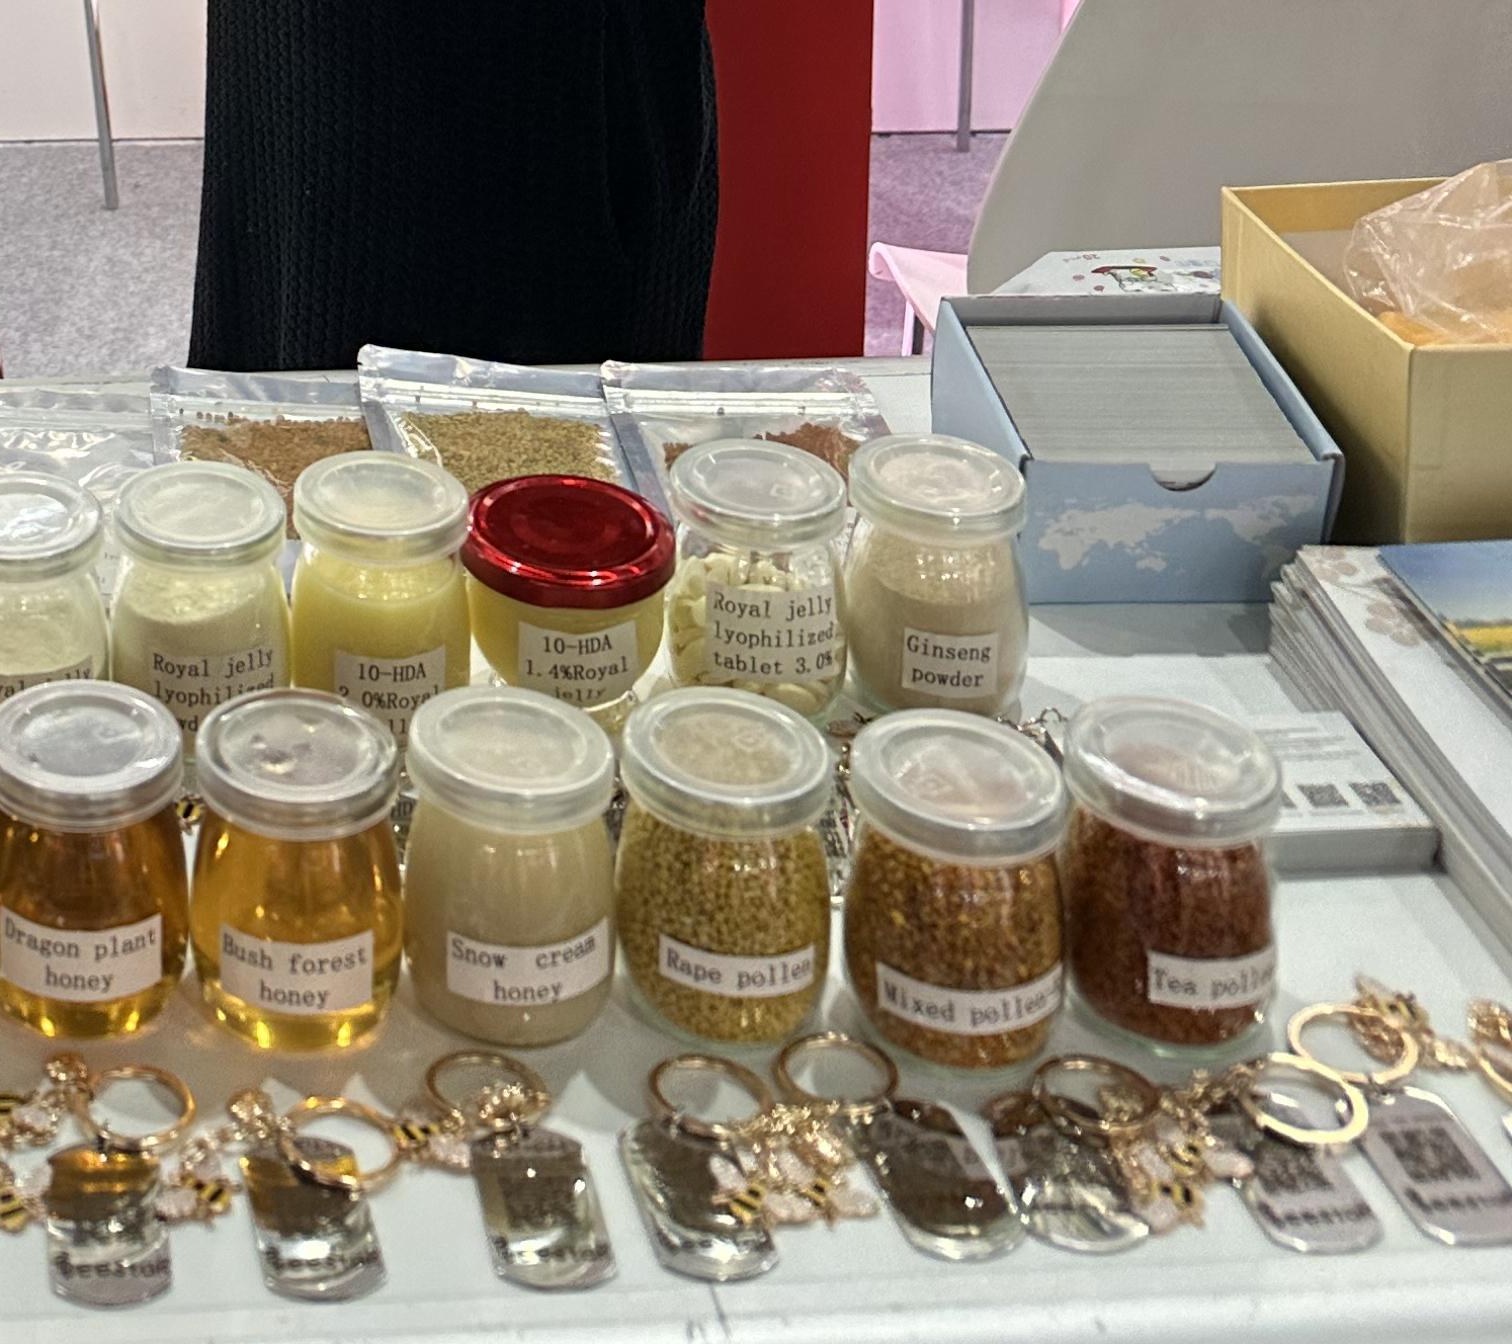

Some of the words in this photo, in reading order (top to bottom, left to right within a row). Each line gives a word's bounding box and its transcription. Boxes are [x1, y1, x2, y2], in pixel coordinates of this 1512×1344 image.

[714, 592, 771, 619] Royal
[786, 595, 833, 622] jelly
[542, 633, 612, 654] 10-HDA
[714, 620, 835, 651] lyophilized
[906, 634, 992, 664] Ginseng
[152, 653, 209, 679] Royal
[224, 648, 274, 679] jelly
[358, 661, 427, 683] 10-HDA
[714, 650, 783, 675] tablet
[910, 664, 985, 690] powder
[4, 918, 83, 962] Dragon
[93, 926, 158, 964] plant
[449, 936, 509, 972] Snow
[534, 934, 597, 970] cream
[288, 943, 368, 978] forest
[44, 965, 116, 994] honey
[258, 978, 331, 1010] honey
[492, 978, 562, 1007] honey
